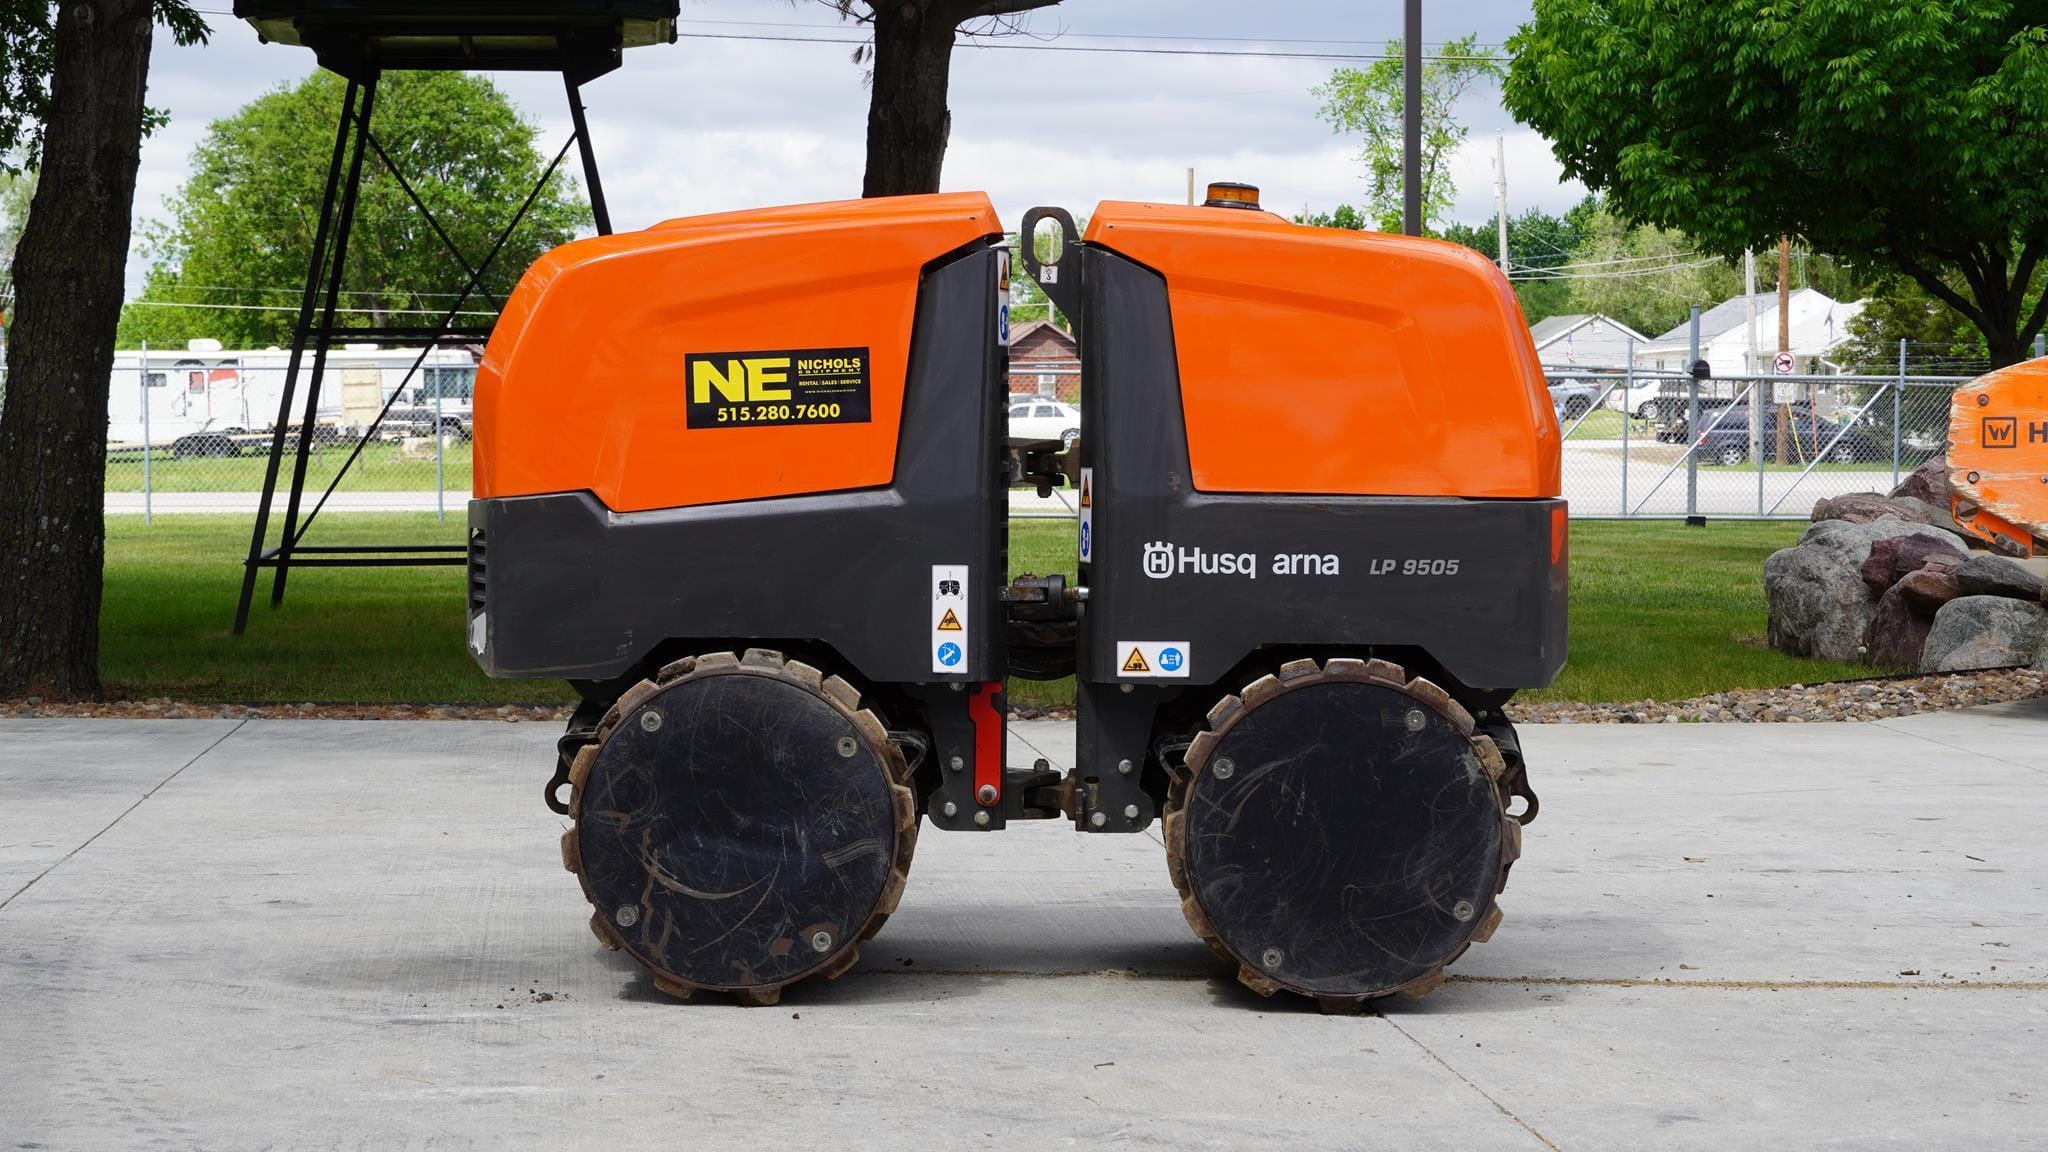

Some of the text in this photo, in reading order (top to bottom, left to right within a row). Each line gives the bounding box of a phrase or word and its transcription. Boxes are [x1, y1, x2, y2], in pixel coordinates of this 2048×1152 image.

[797, 358, 861, 370] NICHOLS
[693, 357, 792, 404] NE
[717, 403, 841, 422] 515.280.7600
[1369, 559, 1460, 576] LP 9505
